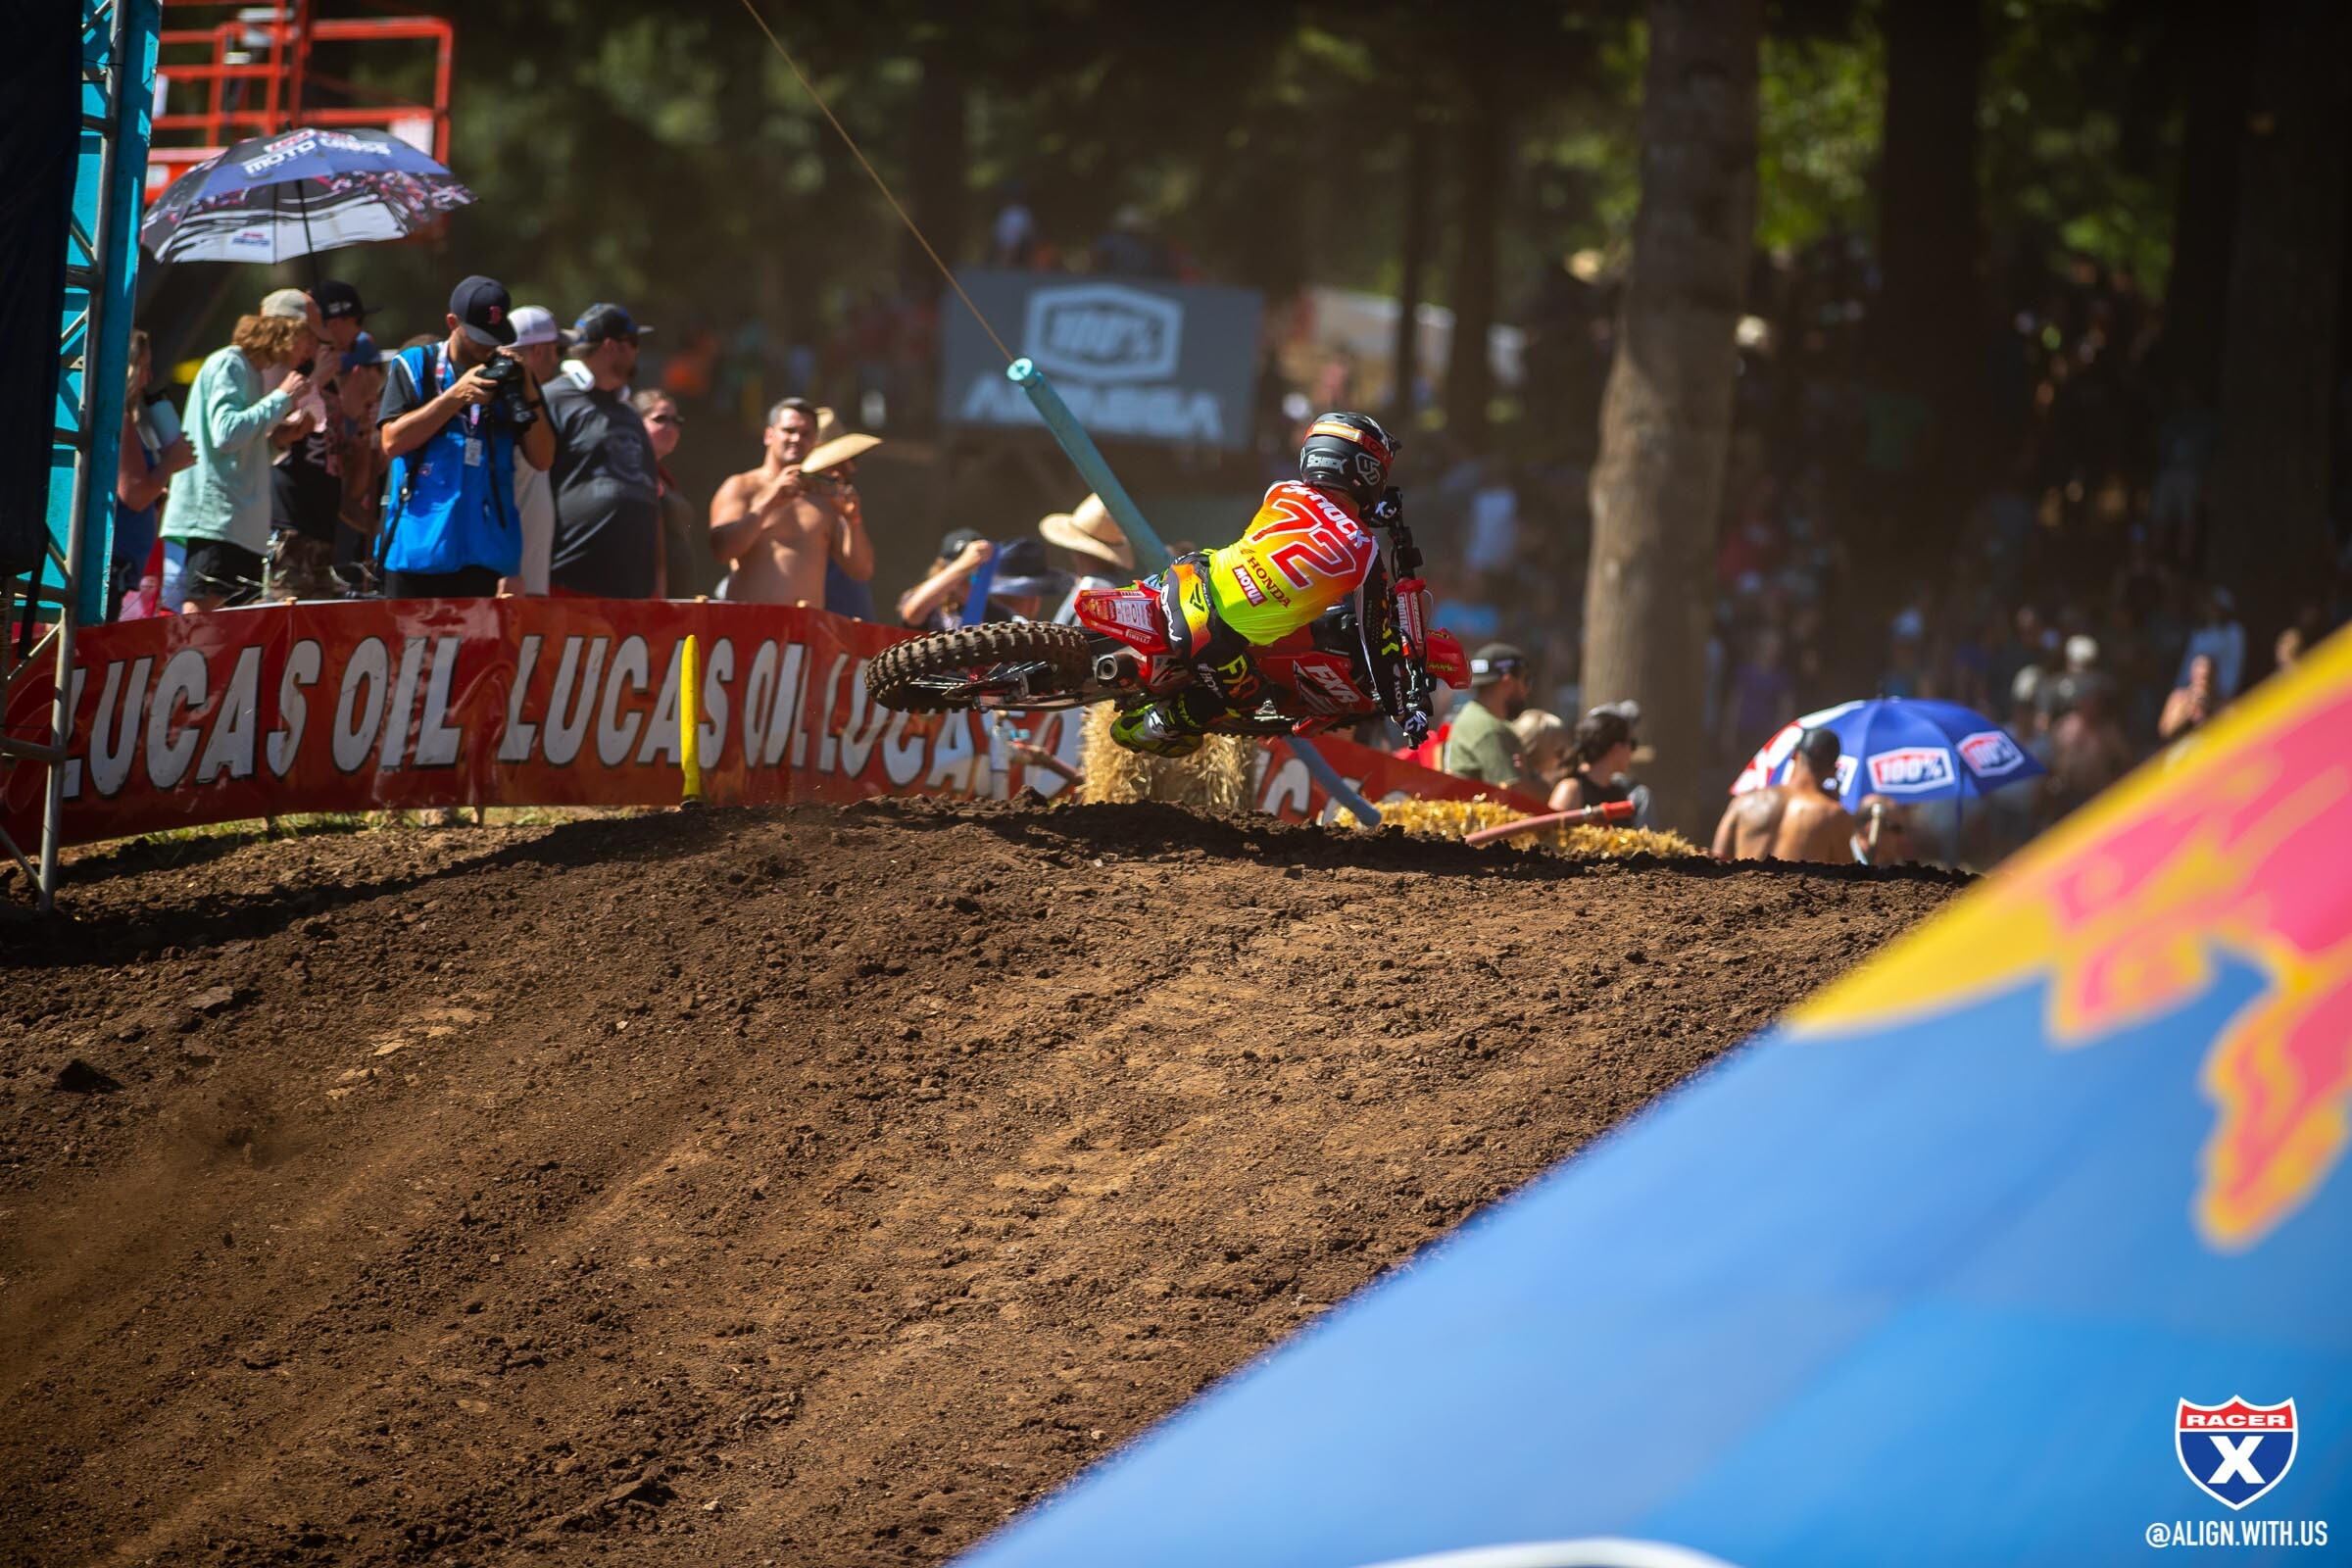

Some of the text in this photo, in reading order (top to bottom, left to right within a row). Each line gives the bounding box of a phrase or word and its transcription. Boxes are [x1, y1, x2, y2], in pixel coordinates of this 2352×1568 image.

[244, 139, 317, 173] MOTO
[1247, 498, 1357, 590] 72
[1233, 565, 1266, 606] MOTUL
[1247, 556, 1292, 608] HONDA
[1304, 664, 1360, 704] FXR
[61, 638, 322, 799] LUCAS
[332, 636, 462, 774] OIL
[497, 635, 735, 769] LUCAS
[744, 638, 811, 769] OIL
[1881, 757, 1942, 784] 100%
